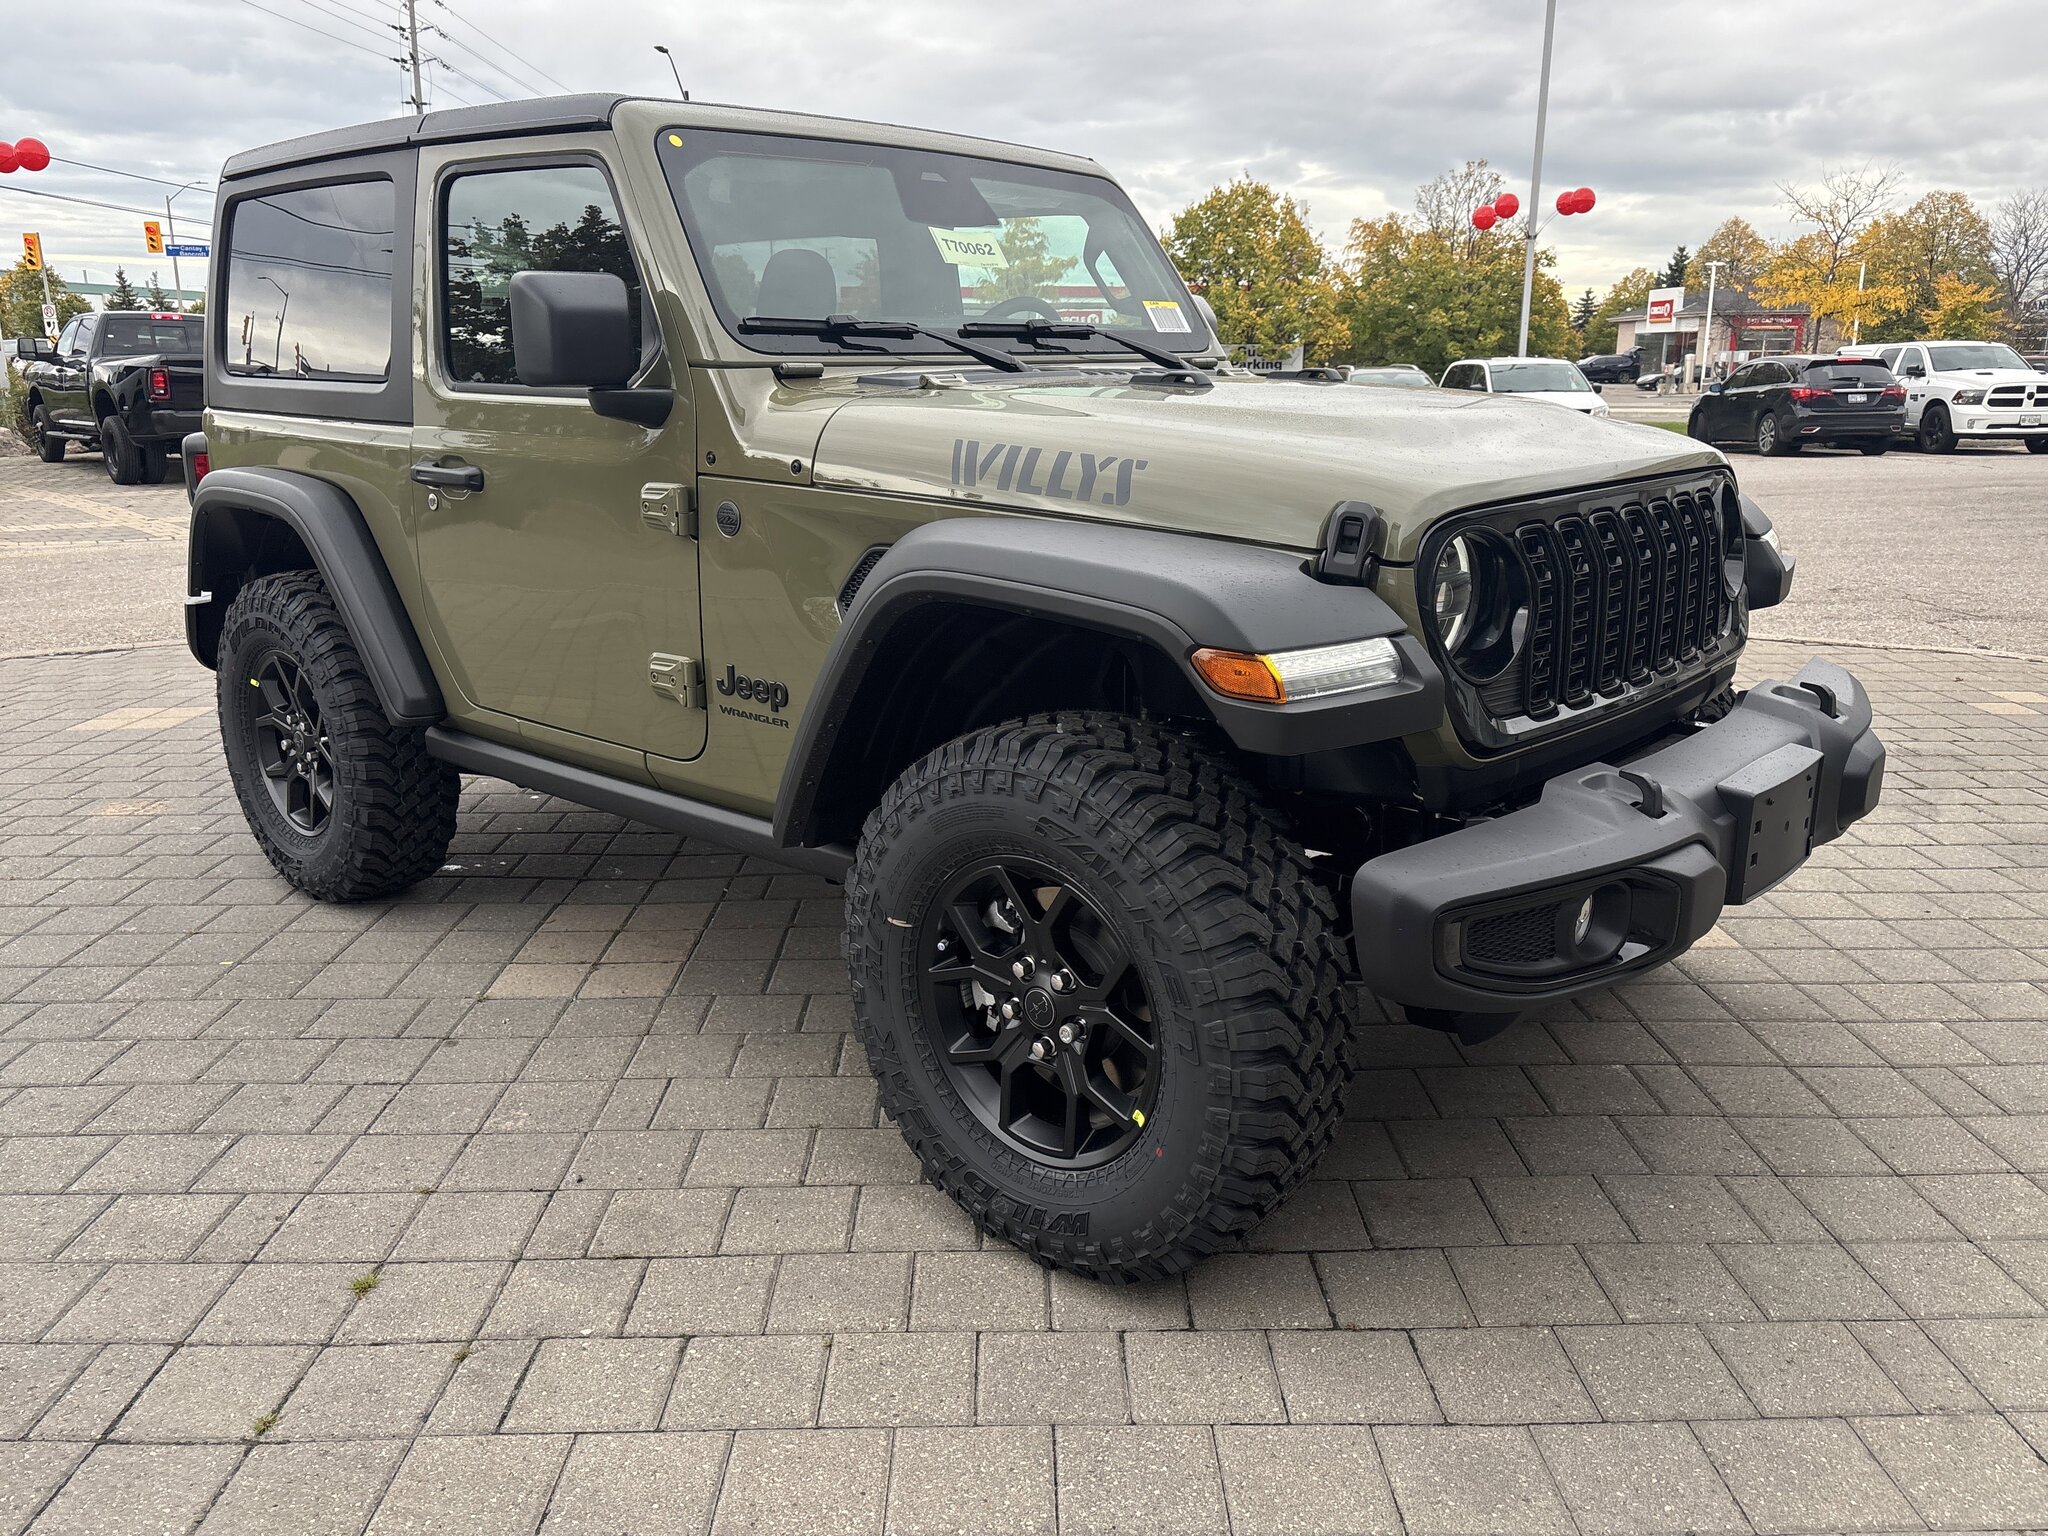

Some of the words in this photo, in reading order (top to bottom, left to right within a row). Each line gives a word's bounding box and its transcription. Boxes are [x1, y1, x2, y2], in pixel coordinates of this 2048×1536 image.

[942, 238, 995, 256] T70062
[1231, 359, 1282, 370] Parking
[951, 439, 1149, 506] WILLYS
[716, 663, 789, 713] Jeep
[719, 704, 789, 729] WRANGLER
[1026, 815, 1200, 1066] FALKEN
[871, 1023, 1090, 1236] WILDPEAK
